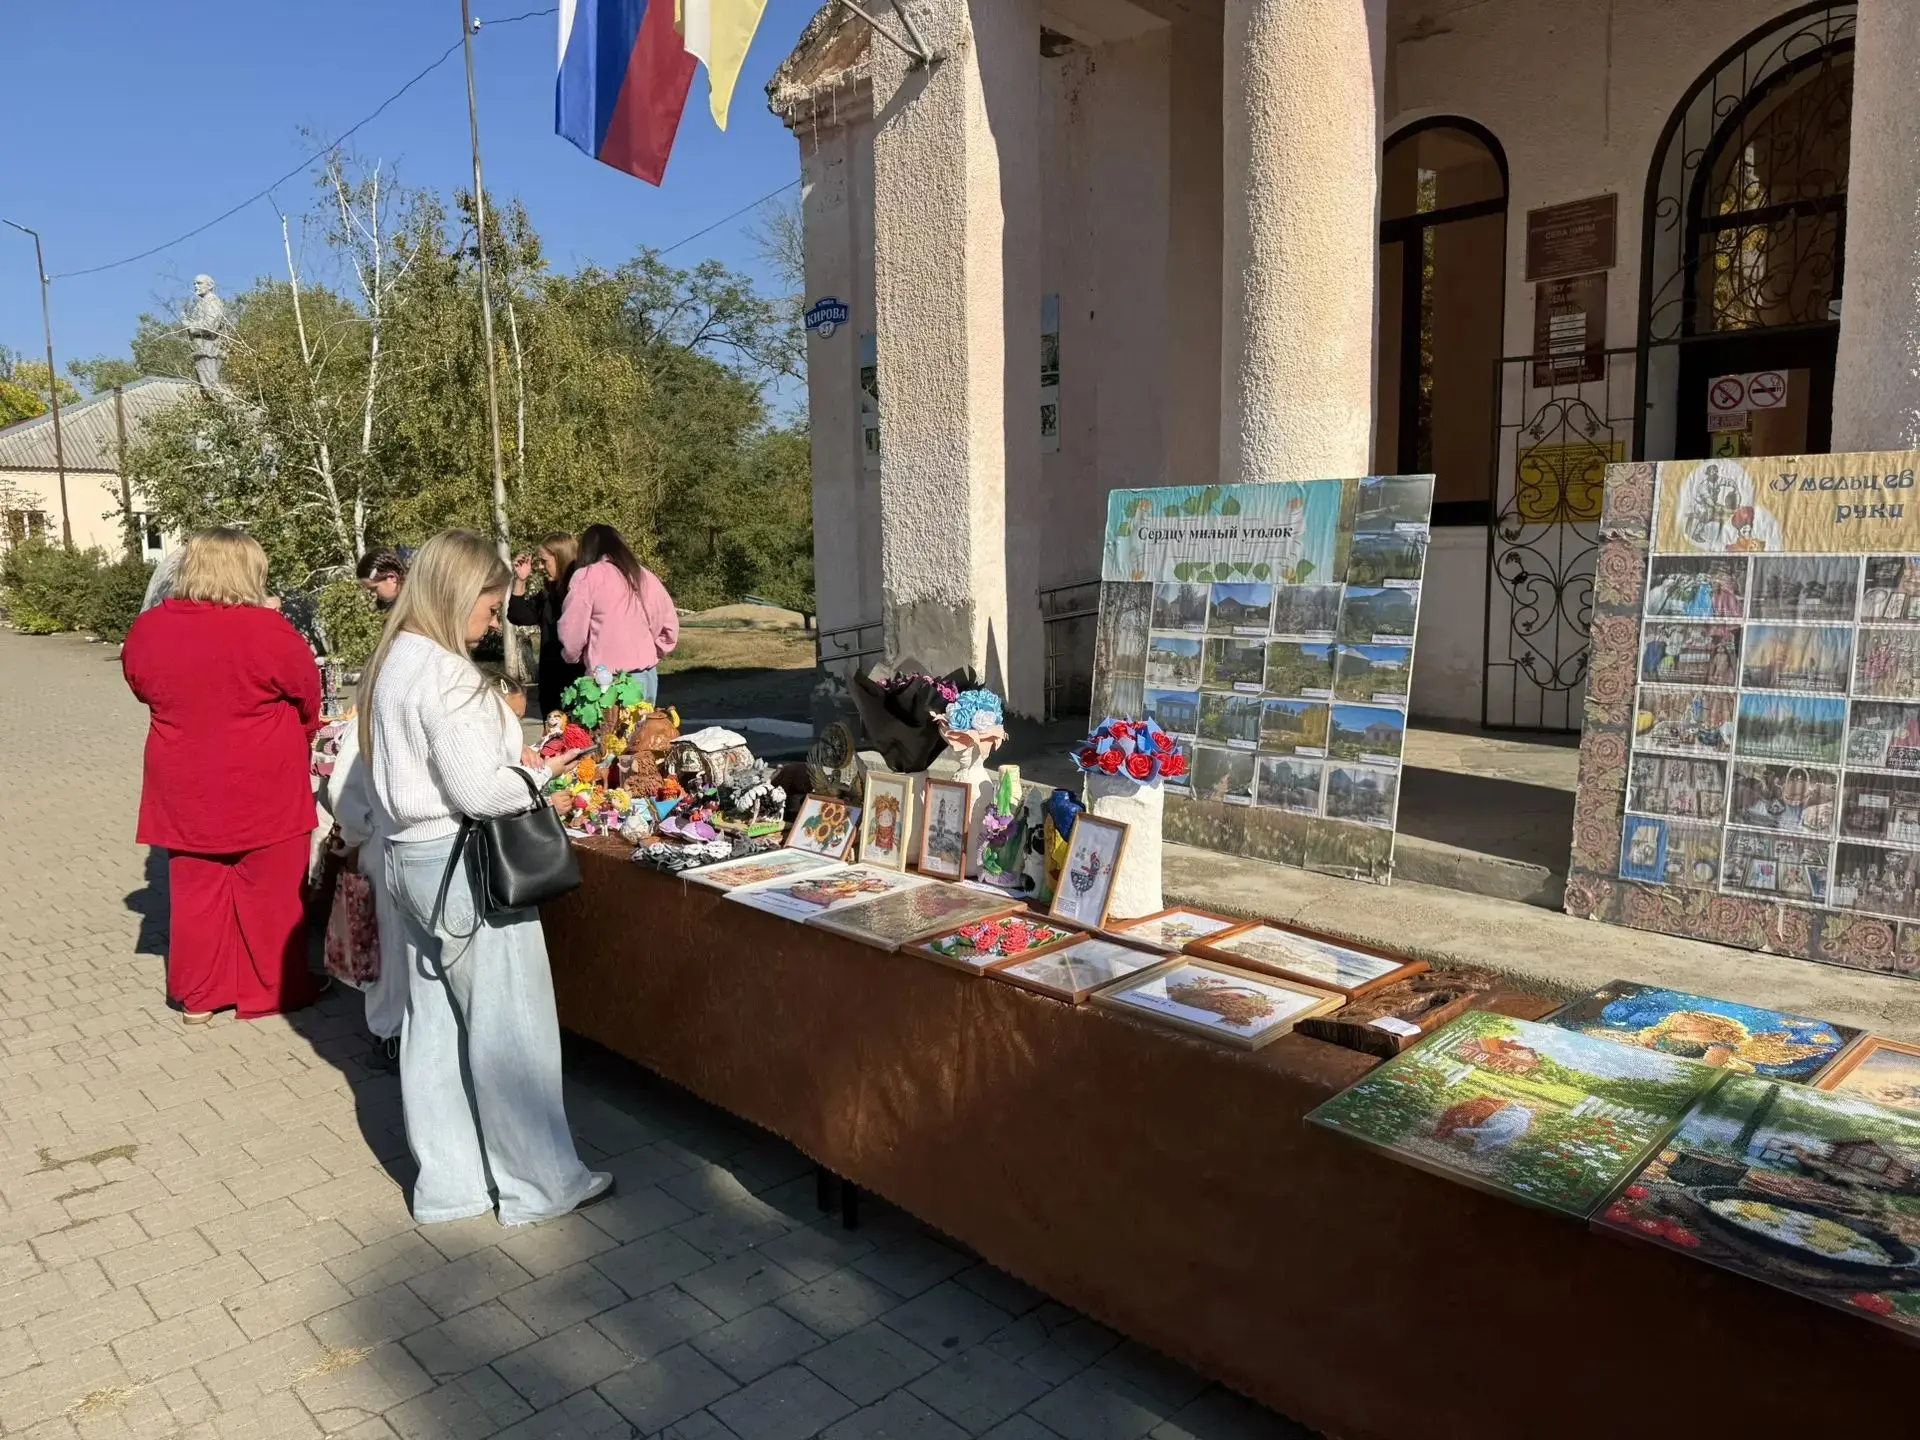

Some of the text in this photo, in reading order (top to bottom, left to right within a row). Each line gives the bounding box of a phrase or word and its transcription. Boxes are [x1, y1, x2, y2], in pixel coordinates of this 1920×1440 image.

[807, 308, 845, 326] КИРОВА
[1835, 502, 1905, 523] руки
[1138, 526, 1293, 544] Сердцу милый уголок
